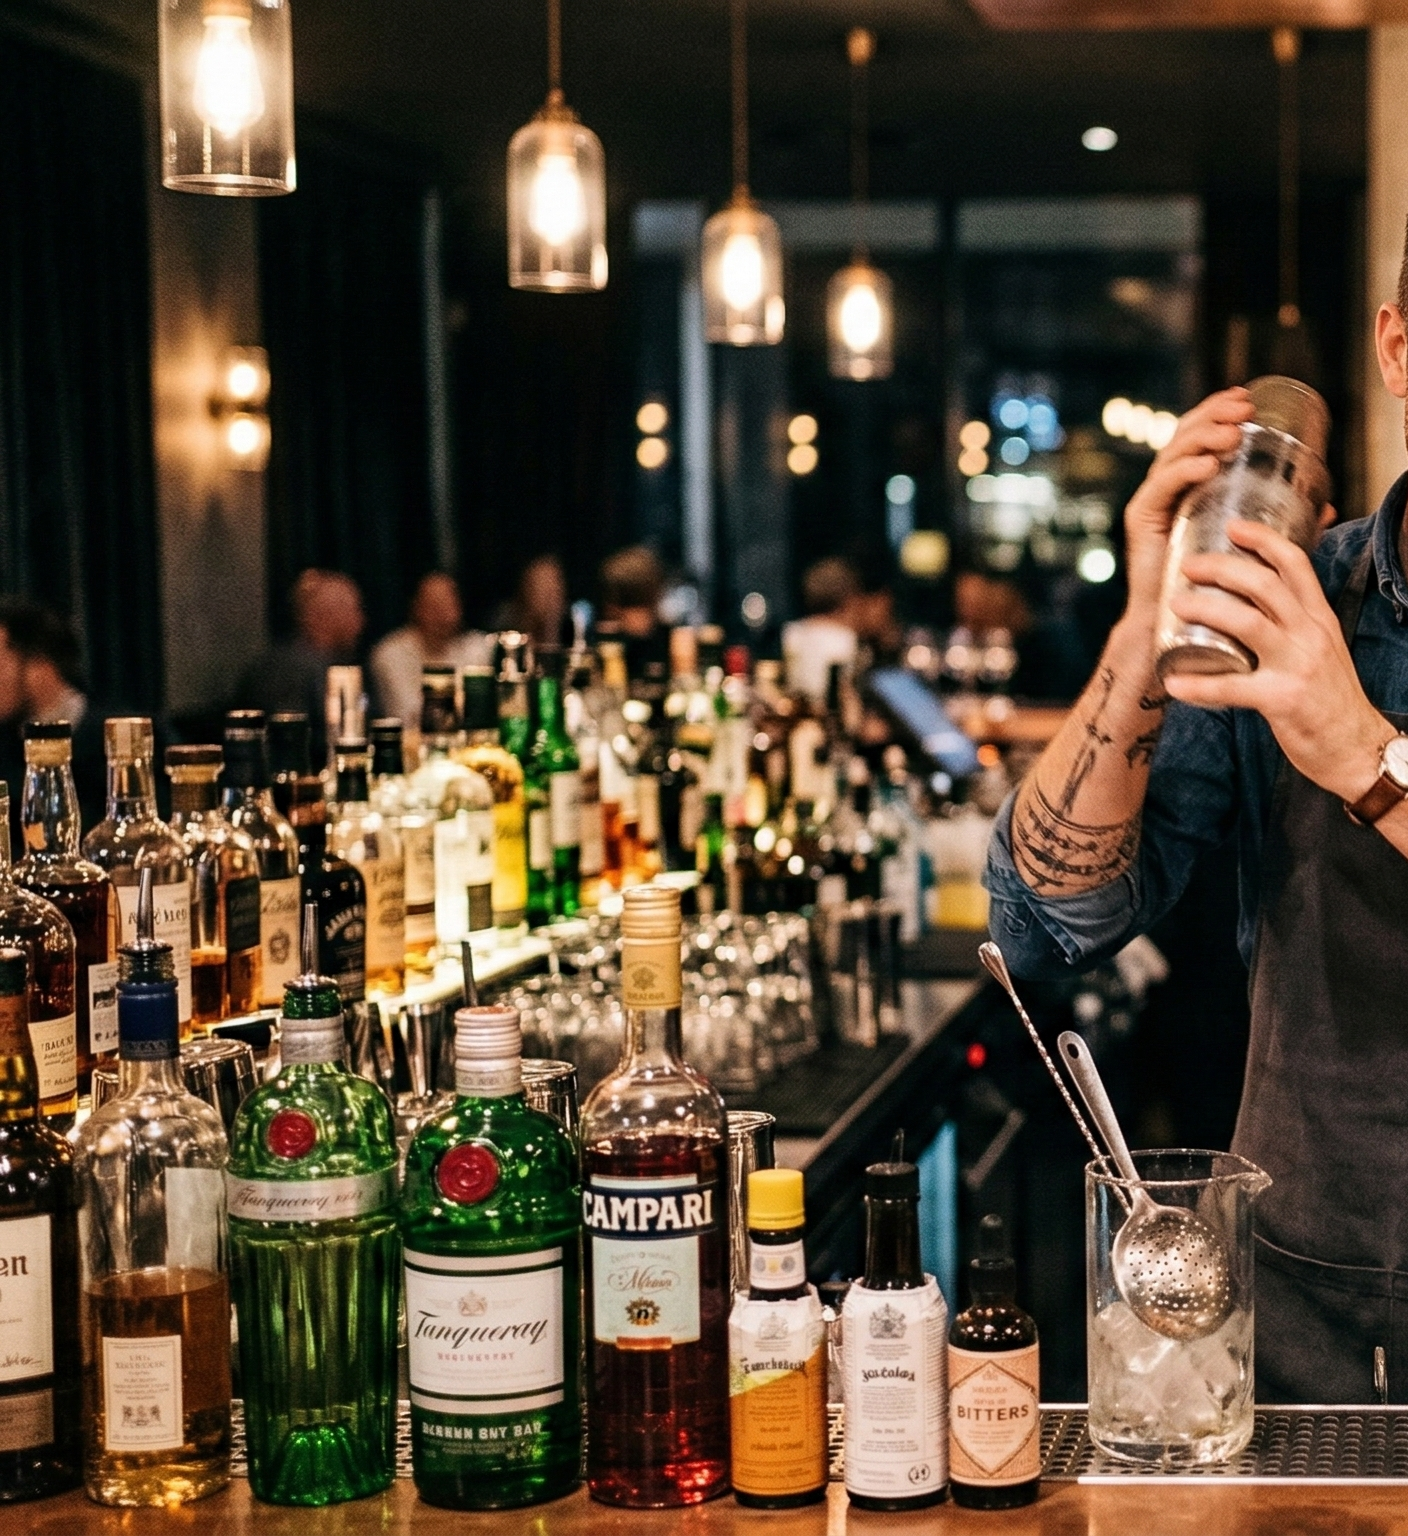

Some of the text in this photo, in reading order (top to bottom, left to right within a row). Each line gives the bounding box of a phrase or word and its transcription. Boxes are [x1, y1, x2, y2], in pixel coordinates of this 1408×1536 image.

[583, 1190, 713, 1232] CAMPARI
[414, 1309, 549, 1350] Tanqueray
[957, 1404, 1030, 1421] BITTERS
